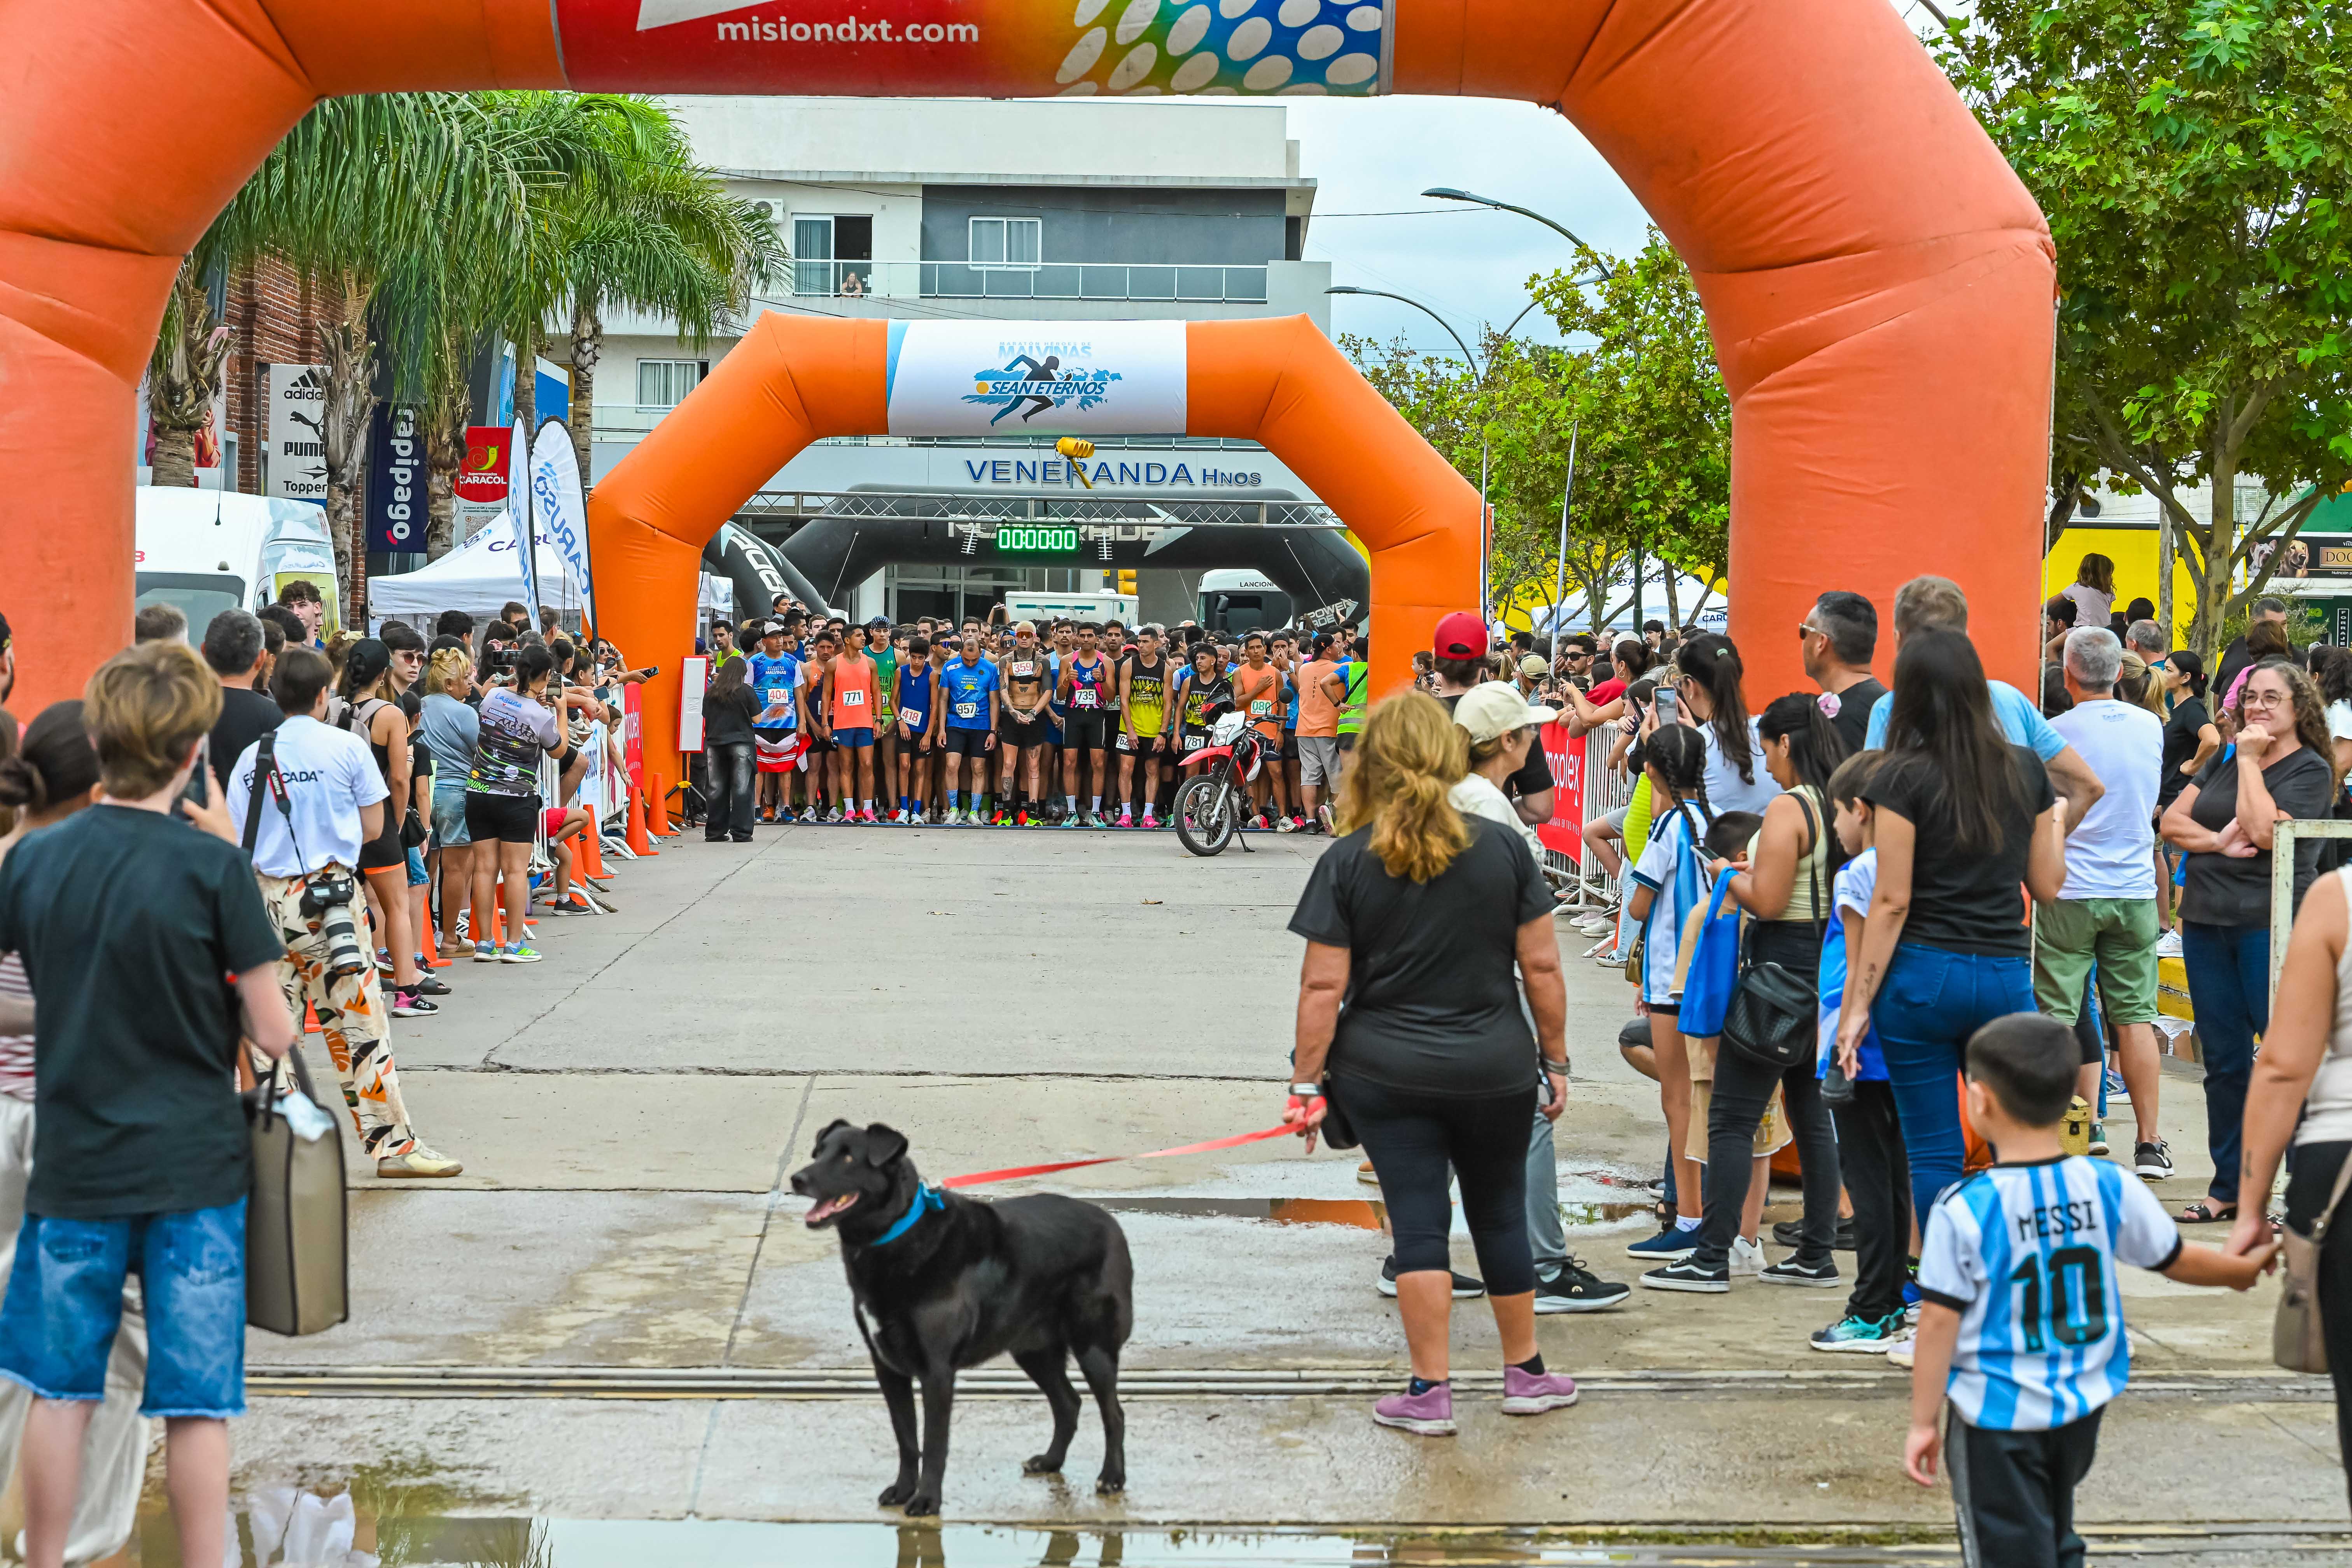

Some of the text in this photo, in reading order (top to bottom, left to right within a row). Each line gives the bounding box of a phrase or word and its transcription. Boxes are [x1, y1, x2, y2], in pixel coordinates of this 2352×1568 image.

[718, 16, 979, 42] misiondxt.com
[998, 346, 1092, 358] MALVINAS
[989, 382, 1108, 395] SEAN ETERNOS
[388, 409, 419, 539] rapipago
[460, 476, 507, 485] CARACOL
[284, 481, 327, 494] Topper
[1014, 662, 1032, 673] 359
[769, 690, 788, 700] 404
[845, 691, 861, 702] 771
[1077, 691, 1094, 700] 735
[957, 704, 975, 714] 957
[902, 710, 919, 722] 418
[1187, 737, 1201, 747] 781
[416, 1000, 430, 1009] FILA
[2018, 1200, 2096, 1241] MESSI
[2009, 1242, 2110, 1354] 10
